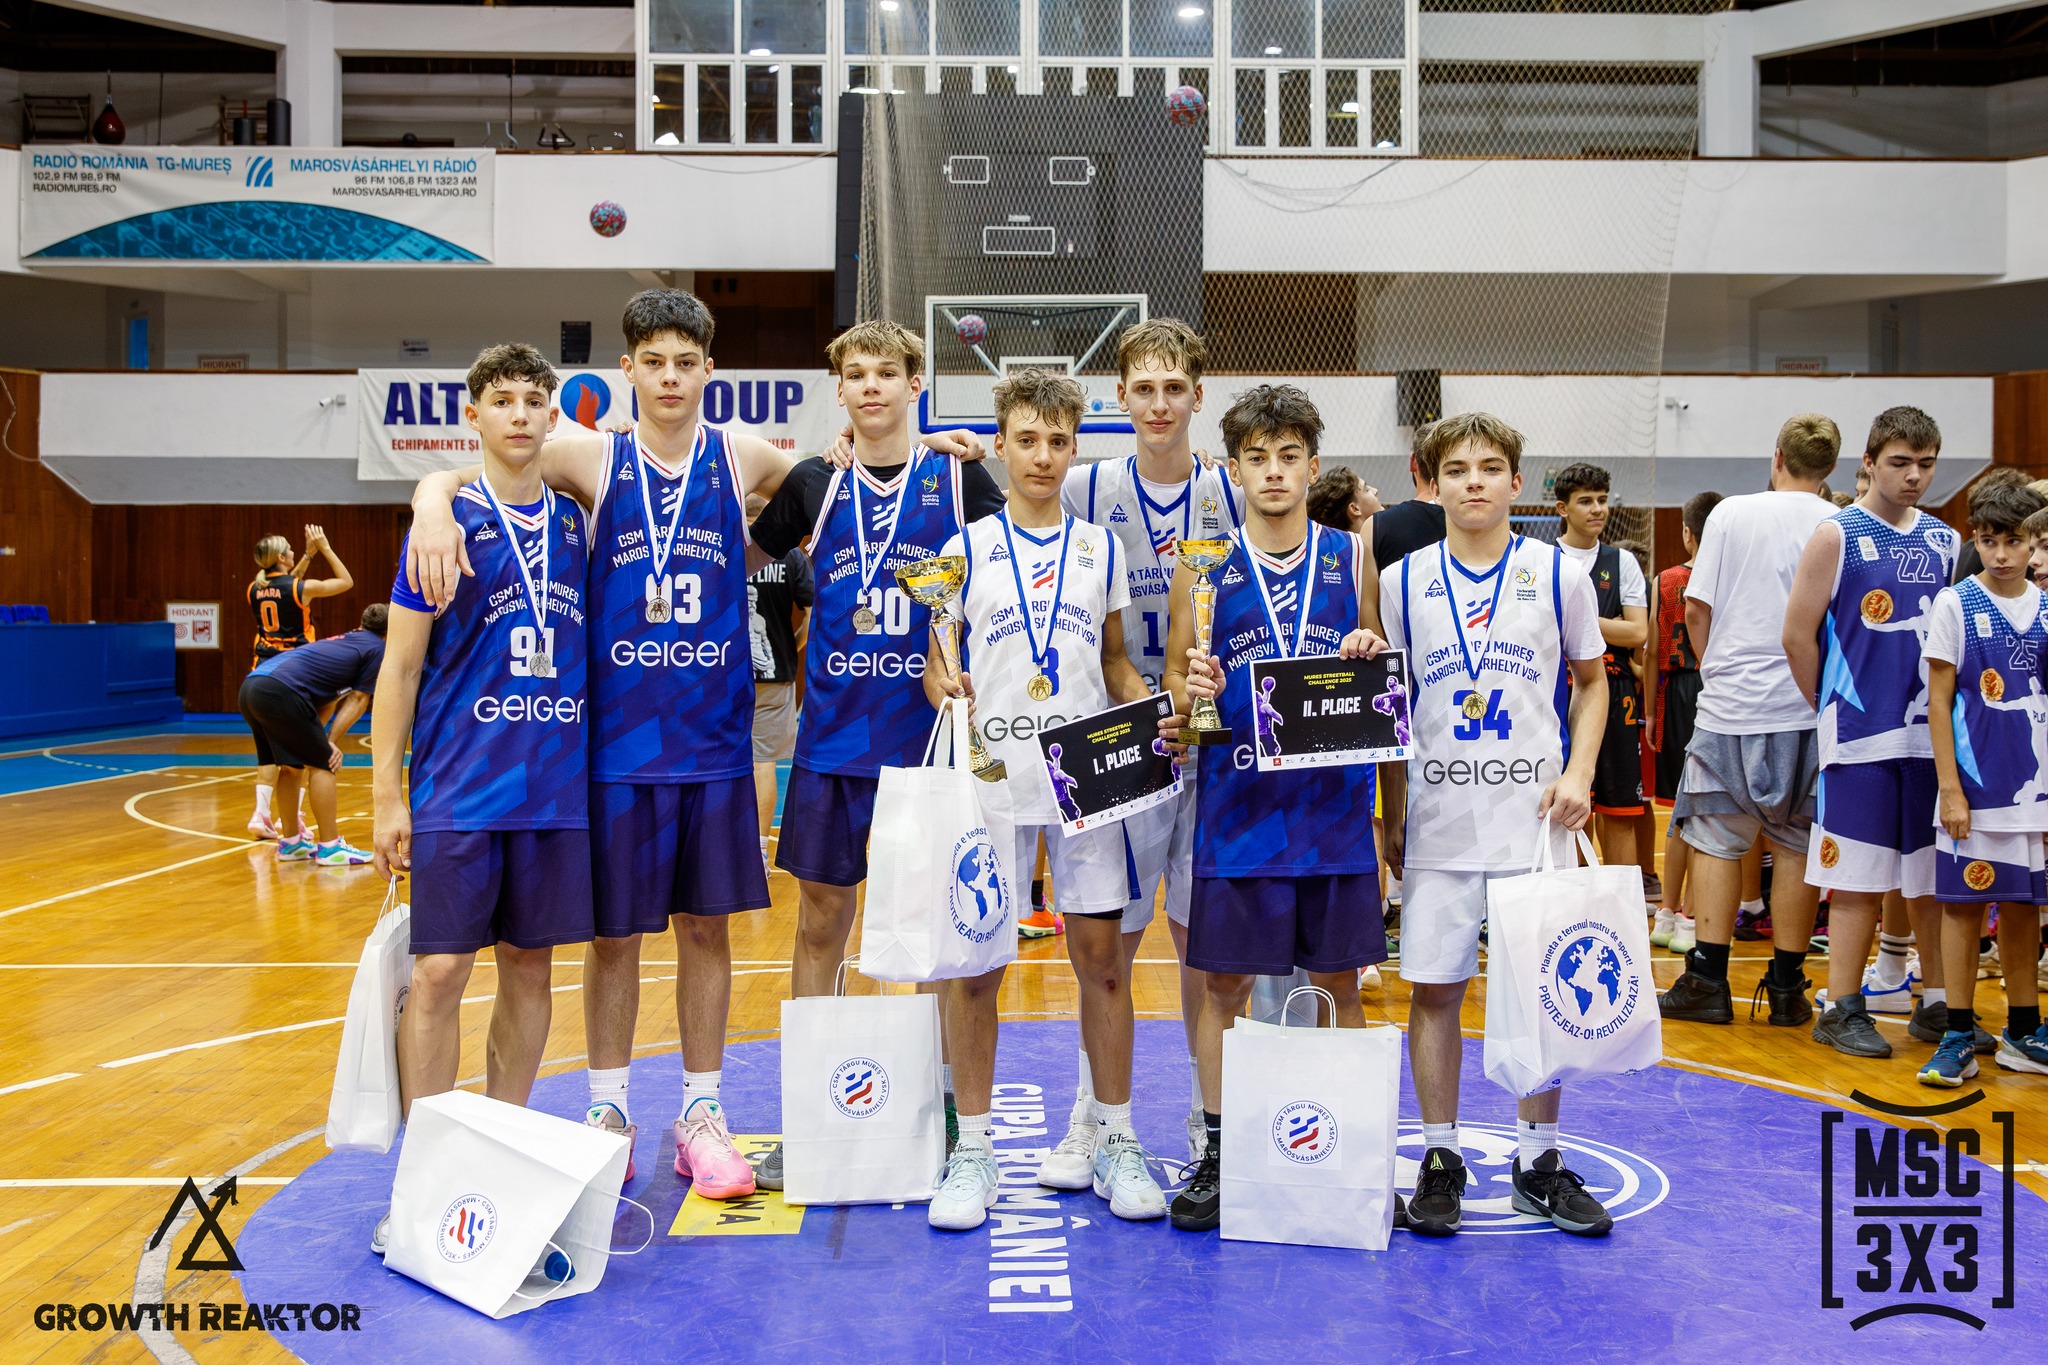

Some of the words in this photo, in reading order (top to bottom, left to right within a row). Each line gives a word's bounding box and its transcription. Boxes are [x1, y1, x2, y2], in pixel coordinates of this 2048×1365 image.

[33, 154, 77, 169] RADIO
[82, 153, 149, 170] ROMÂNIA
[290, 156, 429, 173] MAROSVÁSÁRHELYI
[433, 157, 477, 173] RÁDIÓ
[63, 172, 78, 181] FM
[106, 173, 121, 182] FM
[354, 176, 368, 185] 96
[371, 177, 385, 185] FM
[418, 177, 432, 185] FM
[435, 176, 459, 186] 1323
[461, 177, 477, 186] AM
[33, 183, 117, 193] RADIOMURES.RO
[332, 187, 477, 198] MAROSVASARHELYIRADIO.RO
[203, 361, 242, 369] HIDRANT
[391, 439, 466, 451] ECHIPAMENTE
[1109, 515, 1129, 523] PEAK
[475, 530, 498, 542] PEAK
[617, 529, 644, 548] CSM
[833, 546, 856, 565] CSM
[989, 553, 1011, 563] PEAK
[1891, 547, 1936, 584] 22
[1222, 574, 1244, 586] PEAK
[256, 588, 281, 600] MARA
[488, 585, 513, 607] CSM
[1425, 589, 1446, 598] PEAK
[172, 608, 214, 616] HIDRANT
[260, 600, 279, 632] 0
[857, 587, 910, 635] 20
[990, 606, 1015, 626] CSM
[1081, 627, 1097, 647] VSK
[1142, 611, 1170, 657] 1
[1228, 630, 1256, 651] CSM
[510, 626, 557, 678] 91
[1426, 646, 1450, 667] CSM
[1493, 641, 1535, 663] MUREȘ
[1323, 671, 1356, 679] STREETBALL
[1522, 665, 1541, 684] VSK
[1302, 700, 1318, 717] II.
[1320, 696, 1362, 716] PLACE
[1453, 689, 1513, 741] 34
[1103, 721, 1133, 735] STREETBALL
[1091, 732, 1120, 744] CHALLENGE
[1105, 744, 1142, 771] PLACE
[1540, 940, 1559, 974] Planeta
[1561, 918, 1589, 937] terenul
[1588, 920, 1611, 935] nostru
[1609, 931, 1619, 942] de
[1617, 940, 1634, 966] sport!
[1539, 985, 1594, 1040] PROTEJEAZ-O!
[1596, 975, 1639, 1039] REUTILIZEAZĂ!
[832, 1073, 841, 1088] CSM
[991, 1083, 1048, 1141] CUPA
[1275, 1115, 1285, 1131] CSM
[481, 1200, 493, 1215] CSM
